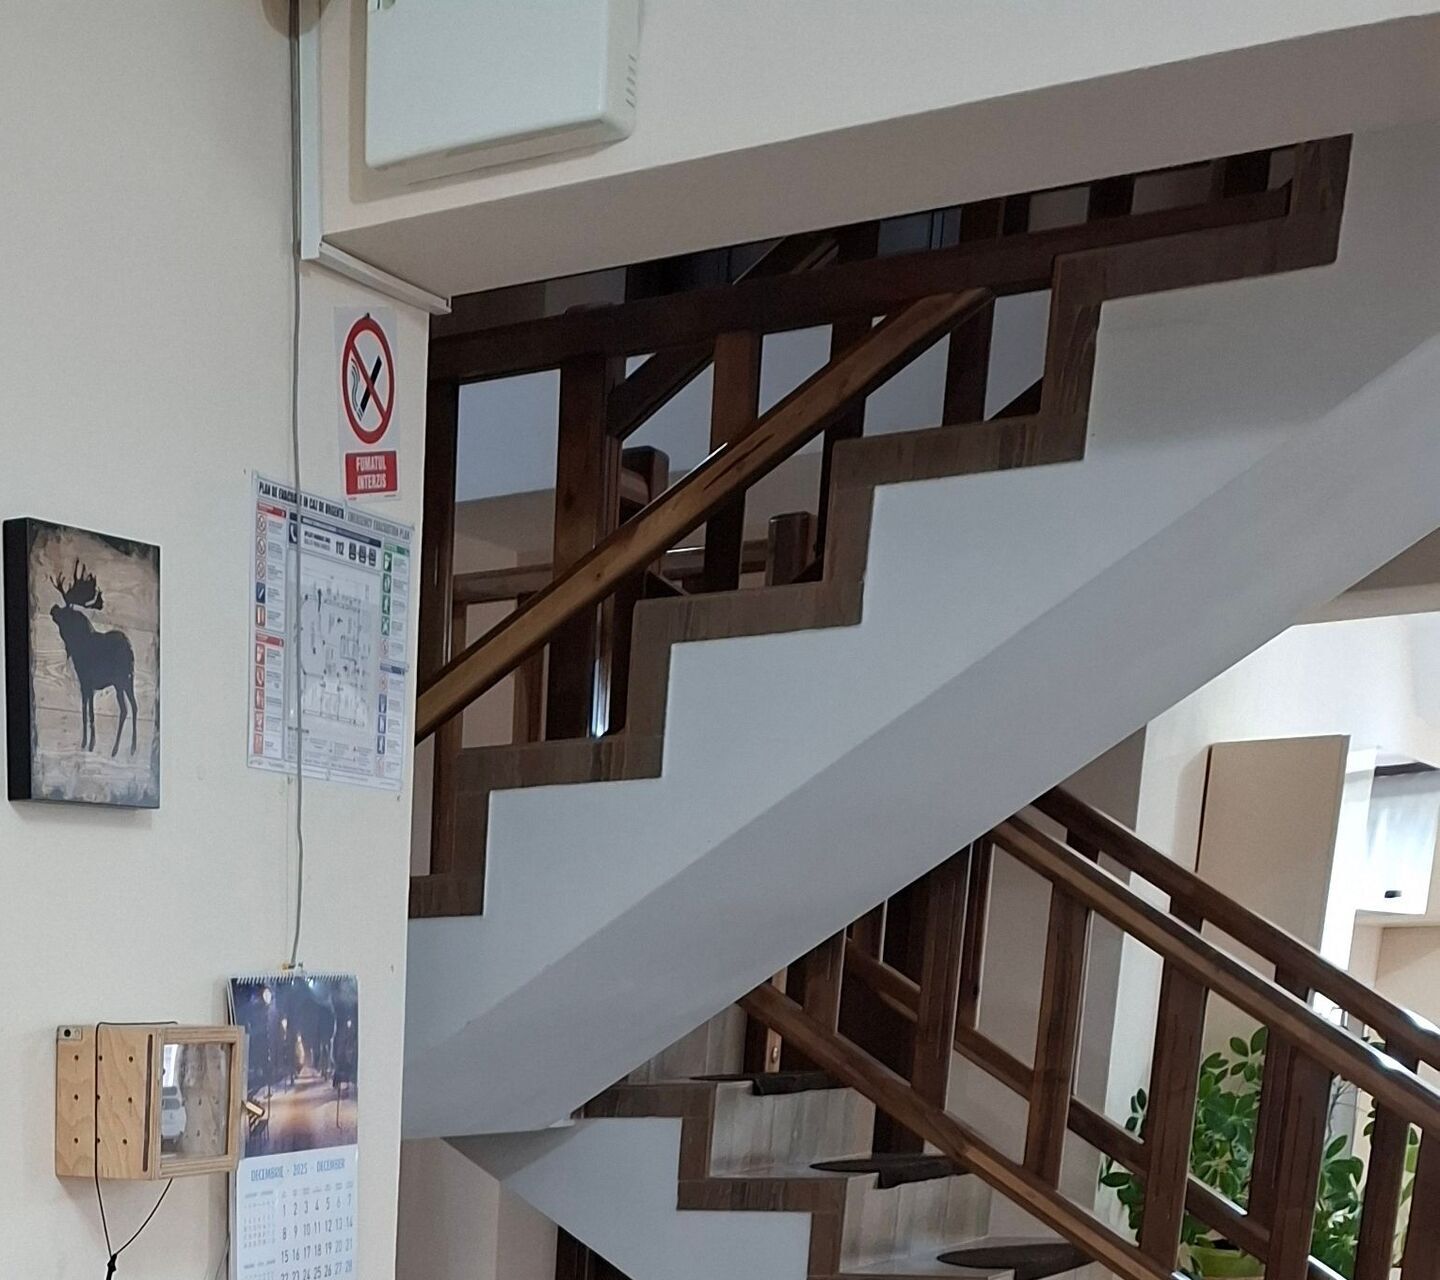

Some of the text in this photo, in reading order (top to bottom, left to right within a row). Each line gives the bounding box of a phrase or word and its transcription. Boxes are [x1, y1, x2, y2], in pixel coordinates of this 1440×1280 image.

[356, 455, 386, 471] FUMATUL
[259, 482, 270, 496] PLAN
[357, 473, 387, 490] INTERZIS
[336, 540, 345, 556] 112
[250, 1164, 284, 1181] DECEMBRIE
[316, 1158, 345, 1173] DECEMBER
[303, 1223, 311, 1236] 10
[314, 1221, 320, 1234] 11
[325, 1219, 332, 1232] 12
[281, 1249, 289, 1263] 15
[292, 1248, 300, 1261] 16
[303, 1245, 311, 1259] 17
[314, 1243, 321, 1256] 18
[325, 1241, 332, 1255] 19
[313, 1265, 321, 1280] 25
[324, 1264, 332, 1278] 26
